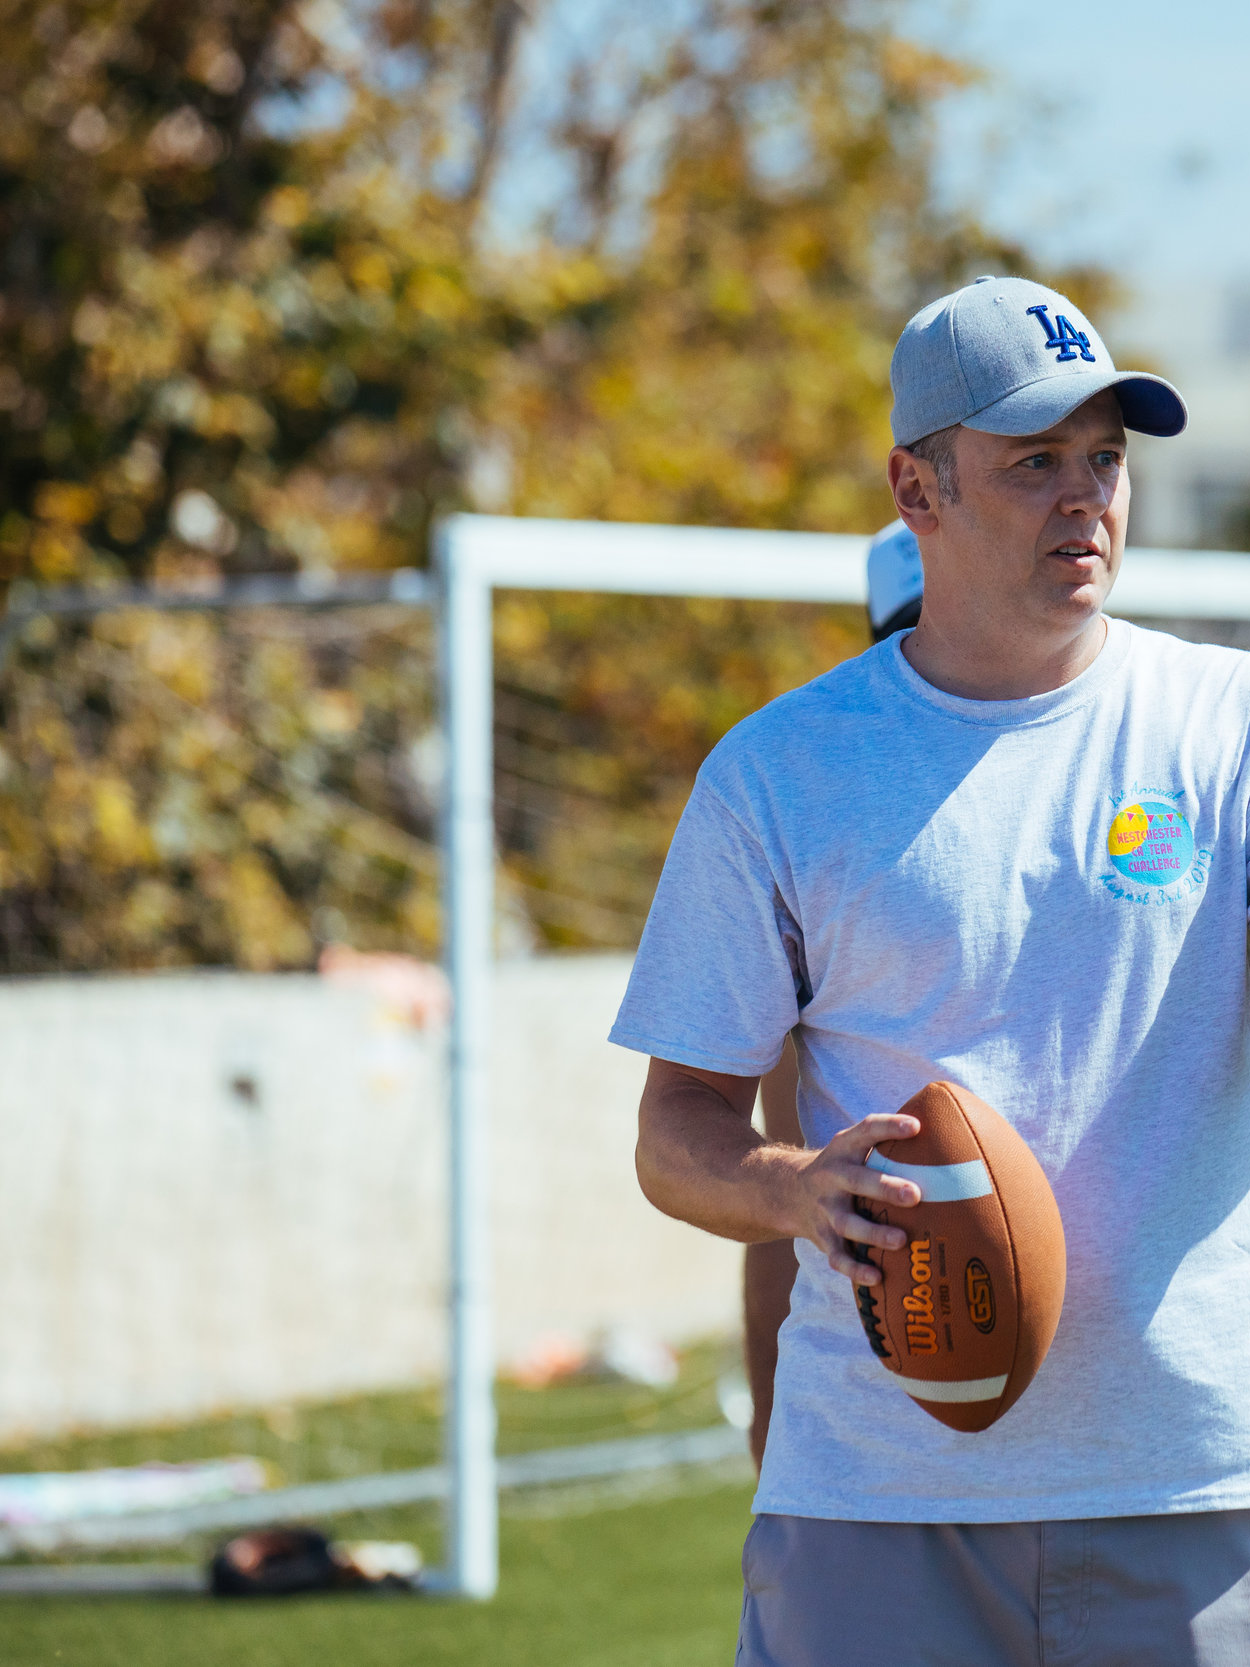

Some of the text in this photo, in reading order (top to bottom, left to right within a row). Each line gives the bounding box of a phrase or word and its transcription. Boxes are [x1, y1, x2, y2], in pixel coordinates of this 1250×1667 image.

[1027, 304, 1096, 362] LA
[1130, 780, 1186, 801] Annual
[1116, 826, 1183, 844] WESTCHESTER
[1131, 842, 1173, 857] CA TEAM
[1128, 857, 1181, 873] CHALLENGE
[1184, 849, 1215, 894] 2019
[902, 1239, 939, 1355] Wilson
[967, 1266, 992, 1323] GST
